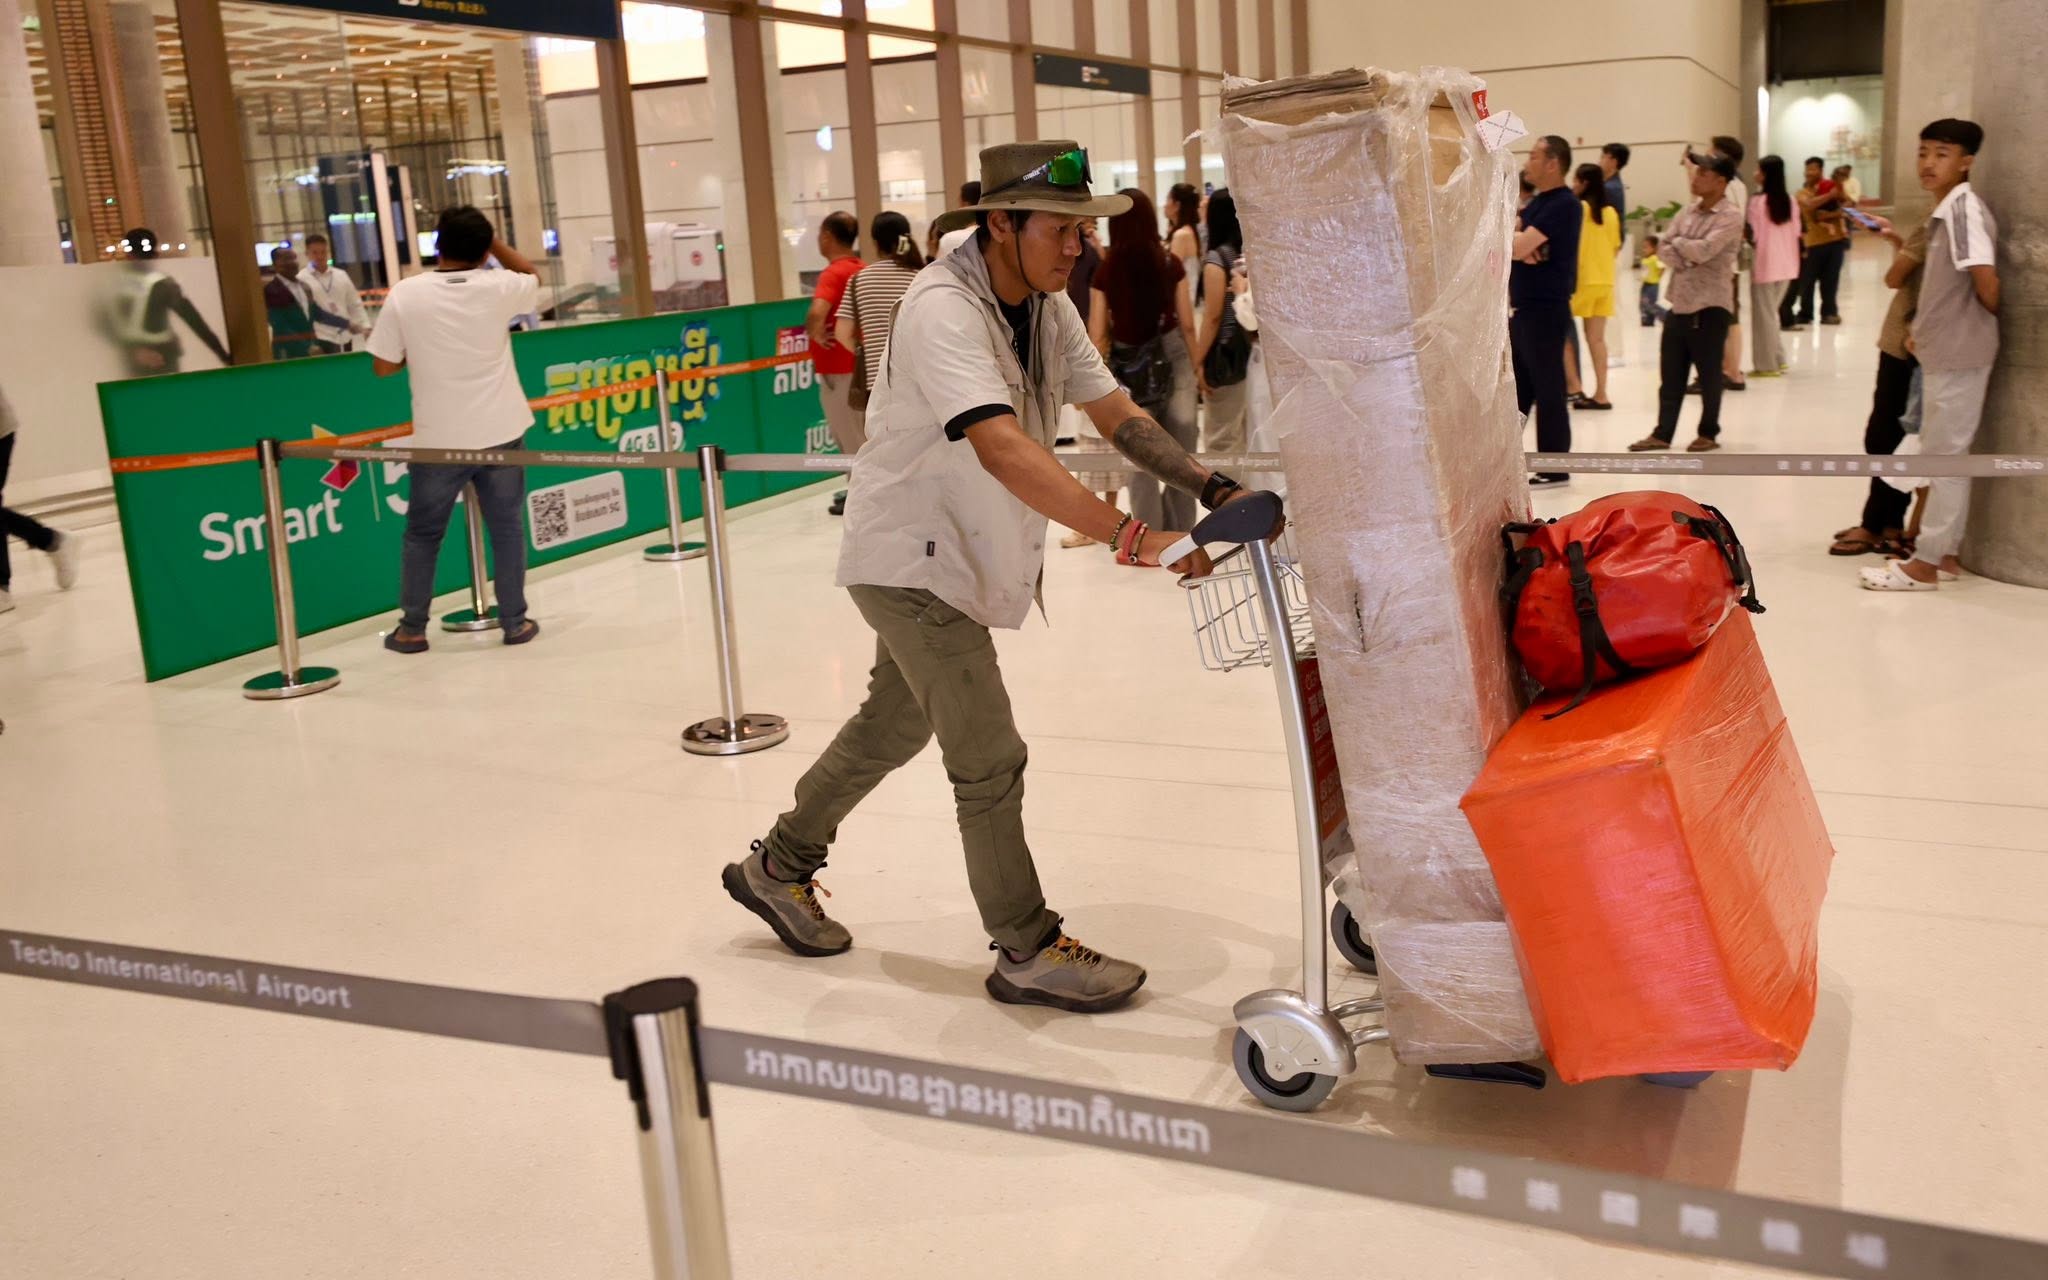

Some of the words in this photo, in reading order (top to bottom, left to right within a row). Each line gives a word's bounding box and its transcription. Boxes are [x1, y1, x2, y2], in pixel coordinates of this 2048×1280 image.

[565, 454, 614, 464] International
[616, 455, 645, 465] Airport
[1993, 459, 2043, 471] Techo
[201, 489, 343, 561] Smart
[9, 938, 81, 971] Techo
[86, 951, 249, 995] International
[255, 972, 352, 1010] Airport
